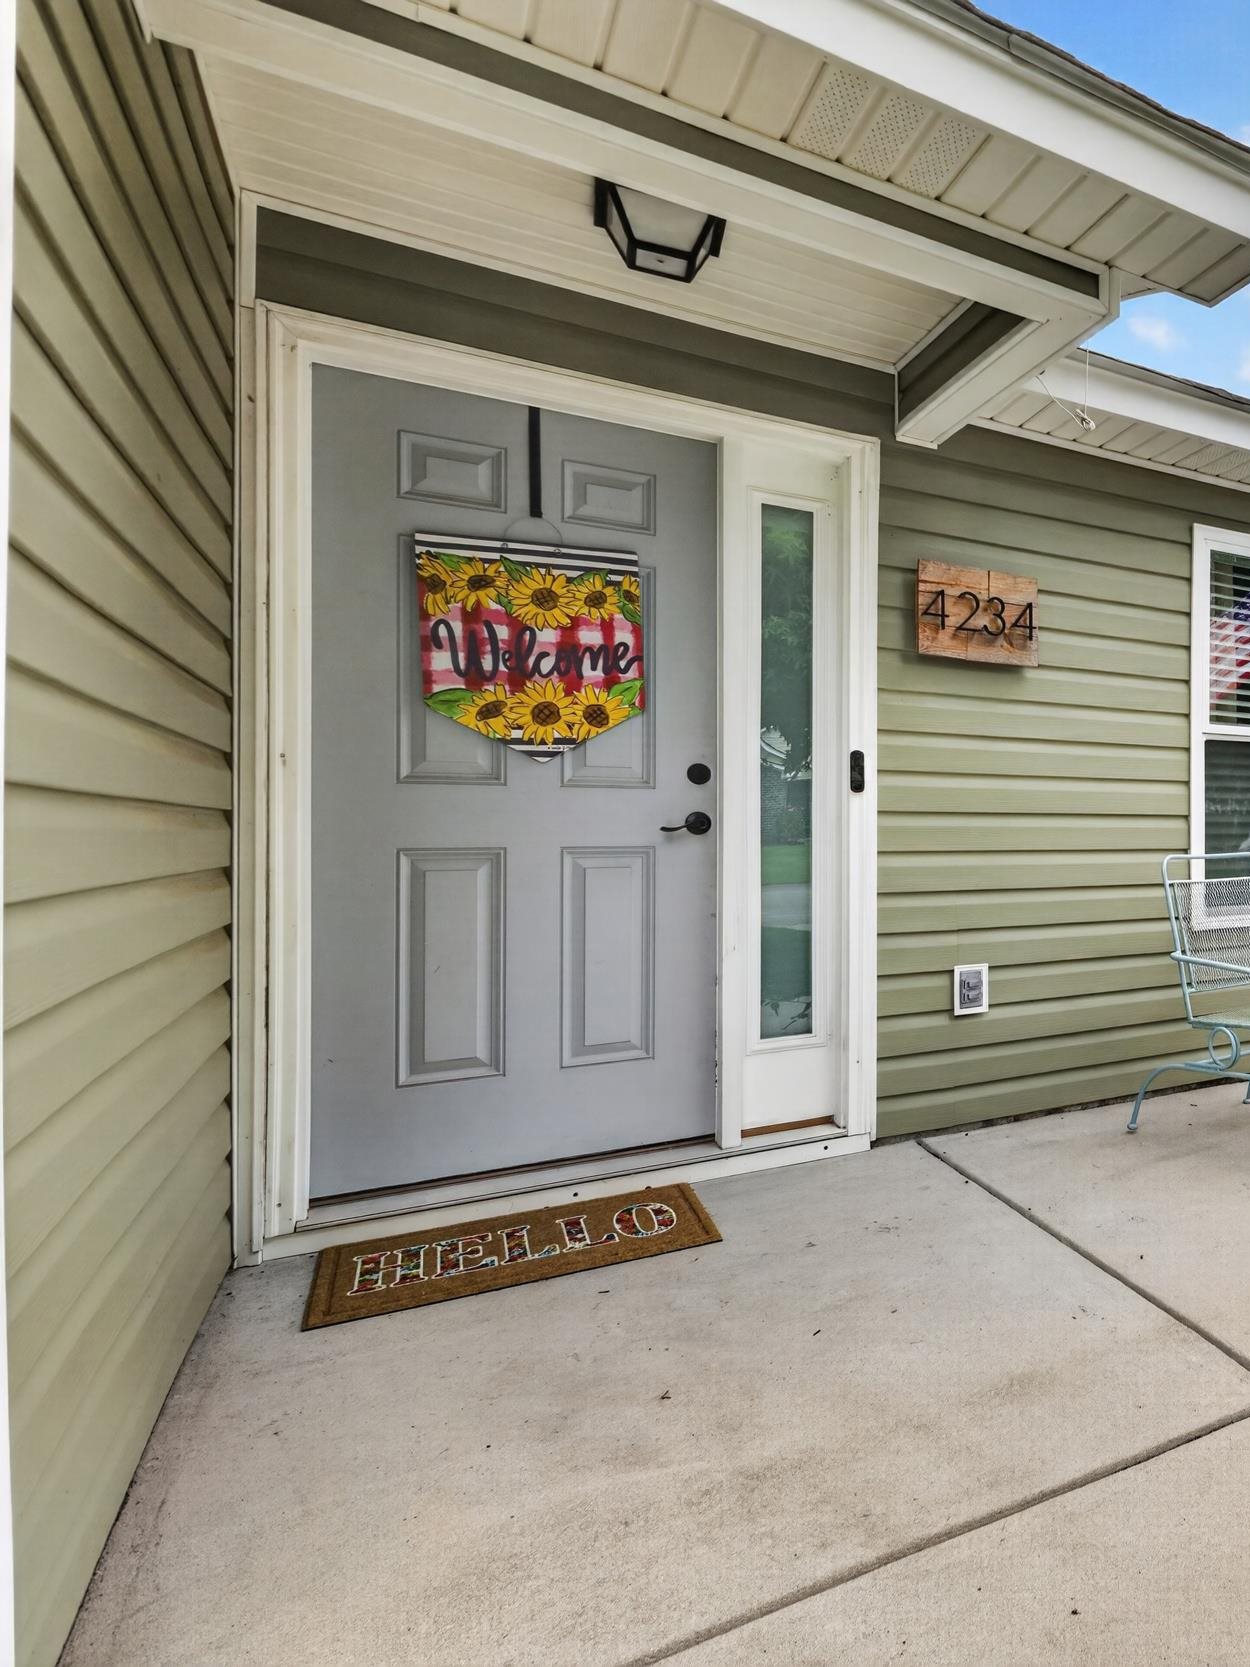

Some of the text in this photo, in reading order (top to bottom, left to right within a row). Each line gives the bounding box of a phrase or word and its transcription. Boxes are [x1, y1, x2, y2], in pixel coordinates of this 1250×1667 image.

[921, 589, 1037, 641] 4234
[430, 617, 643, 682] Welcome
[347, 1202, 677, 1296] HELLO
